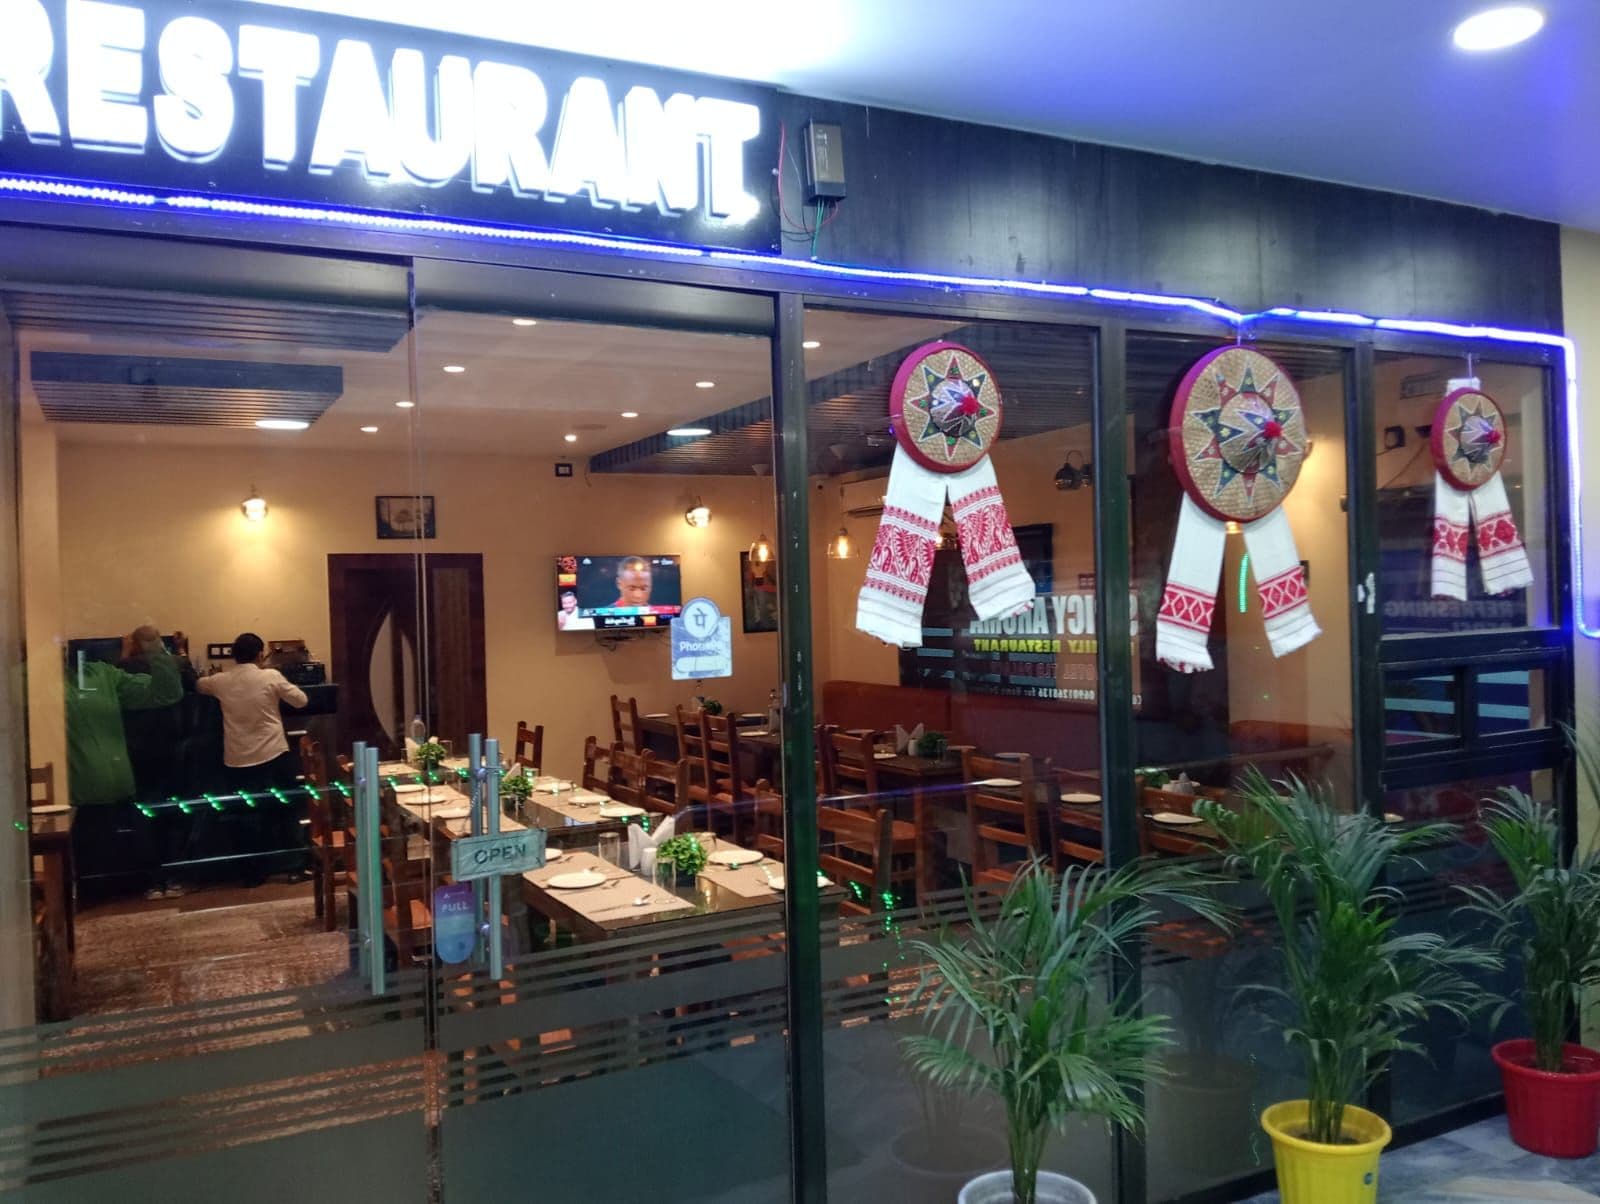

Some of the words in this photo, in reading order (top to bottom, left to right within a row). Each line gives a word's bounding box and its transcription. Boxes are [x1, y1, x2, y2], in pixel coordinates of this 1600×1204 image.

[0, 0, 760, 225] RESTAURANT
[474, 844, 526, 865] OPEN
[441, 901, 469, 913] PULL
